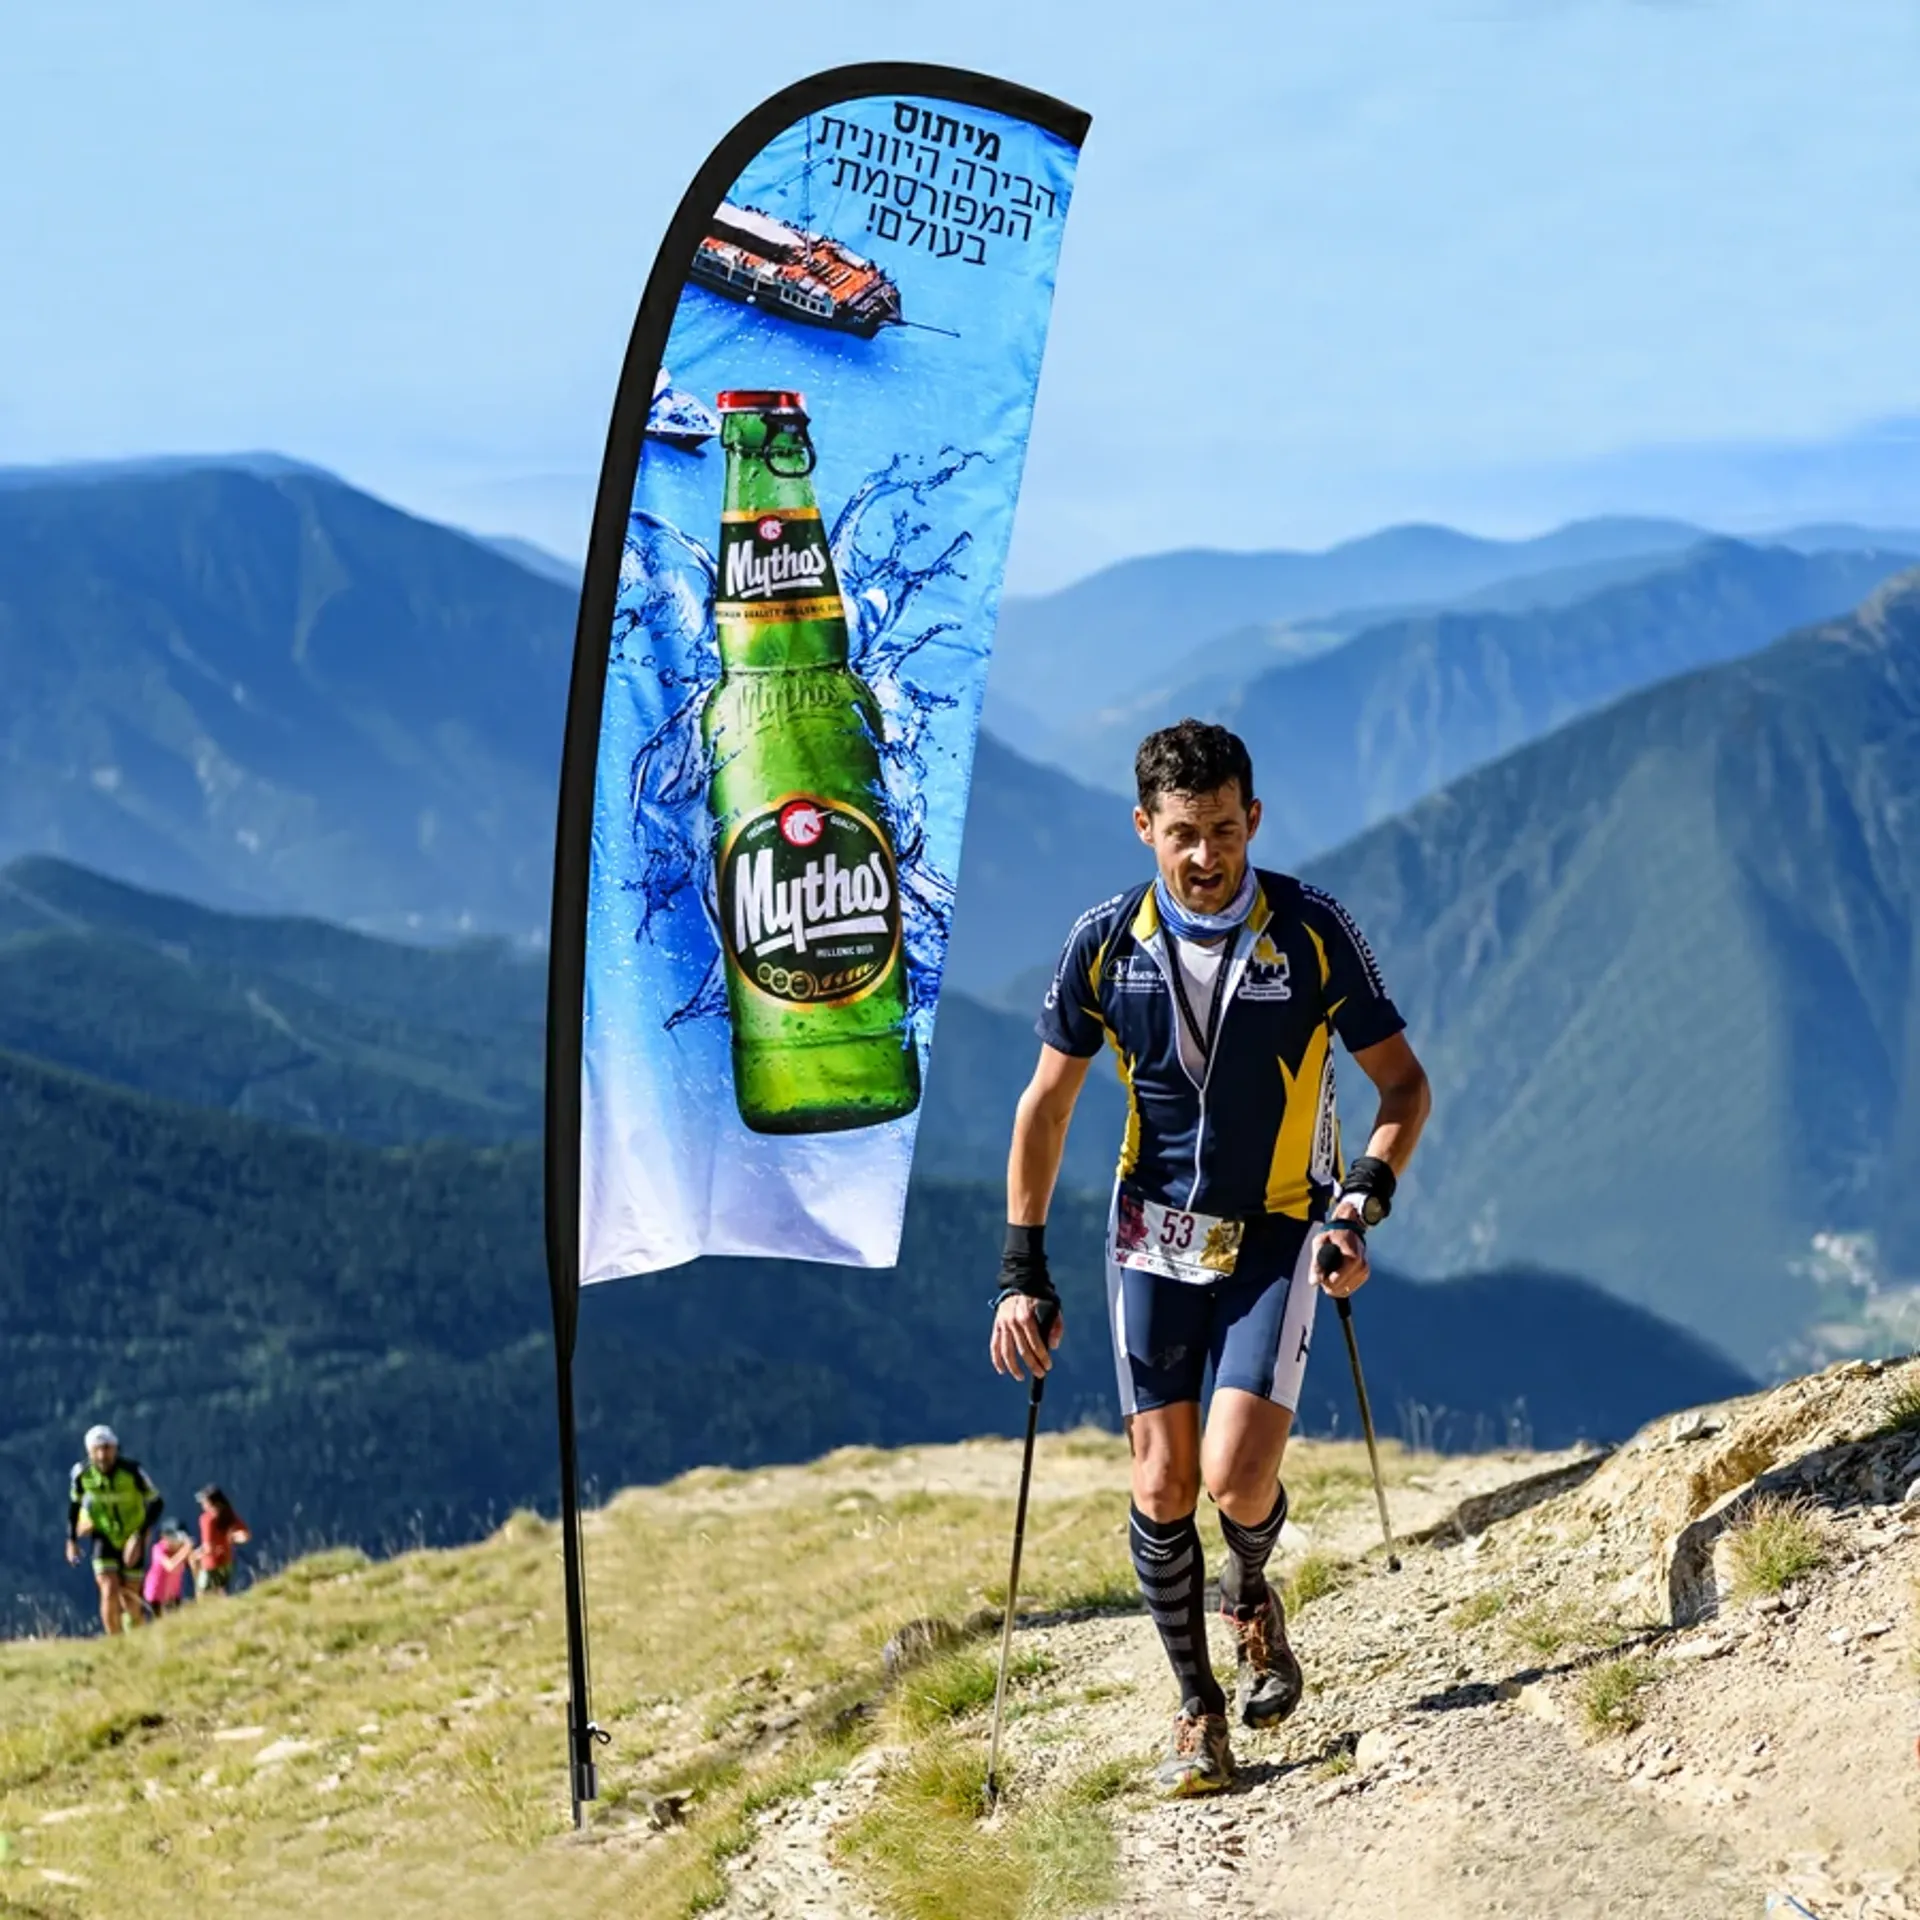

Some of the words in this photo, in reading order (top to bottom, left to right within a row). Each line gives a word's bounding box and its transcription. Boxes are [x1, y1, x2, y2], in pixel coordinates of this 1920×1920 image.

[816, 116, 940, 179] היוונית
[894, 101, 1001, 162] מיתוס
[832, 157, 1032, 241] המפורסמת
[951, 157, 1056, 218] הבירה
[865, 203, 987, 266] בעולם!
[725, 539, 827, 598] Mythos
[735, 848, 891, 954] Mythos
[1159, 1210, 1196, 1249] 53
